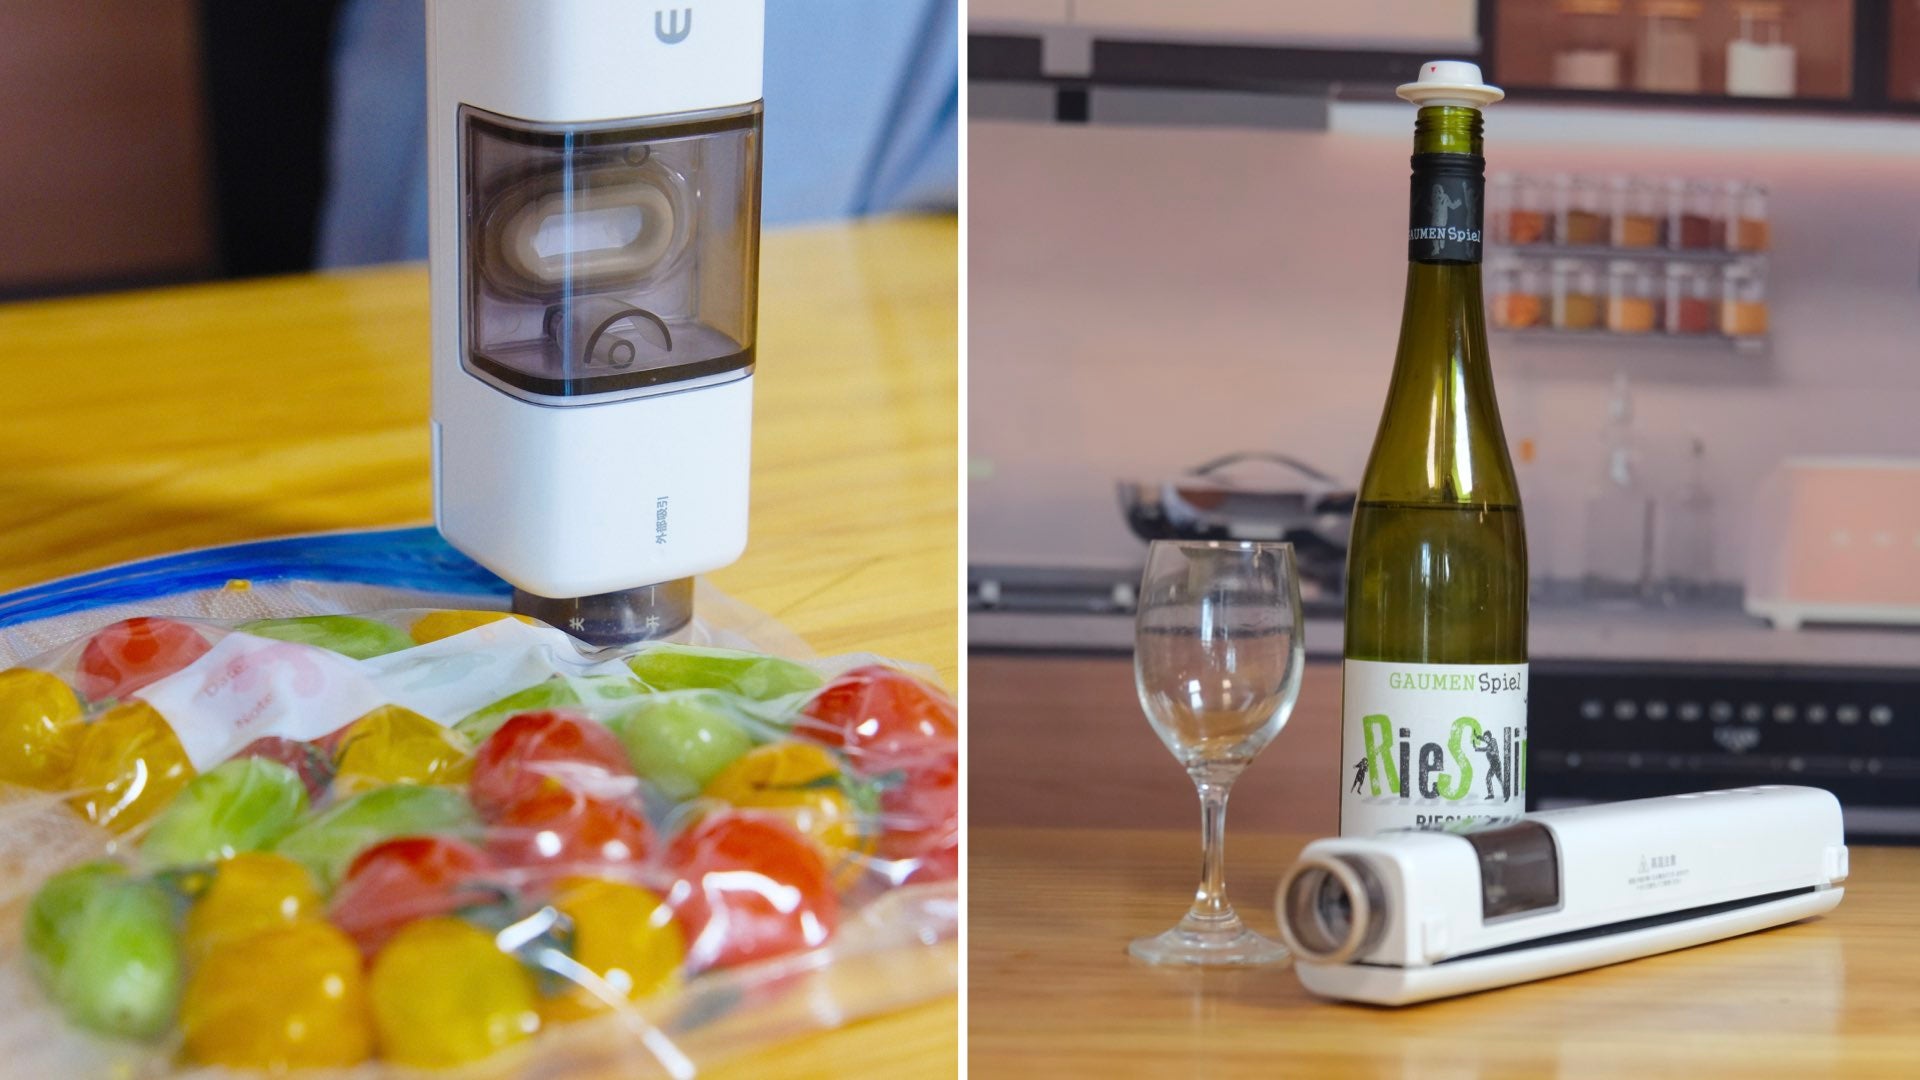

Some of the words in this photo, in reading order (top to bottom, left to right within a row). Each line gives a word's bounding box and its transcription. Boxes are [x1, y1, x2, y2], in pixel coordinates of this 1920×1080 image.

[656, 496, 669, 544] 外部吸引
[569, 617, 585, 632] 关
[645, 614, 660, 630] 开
